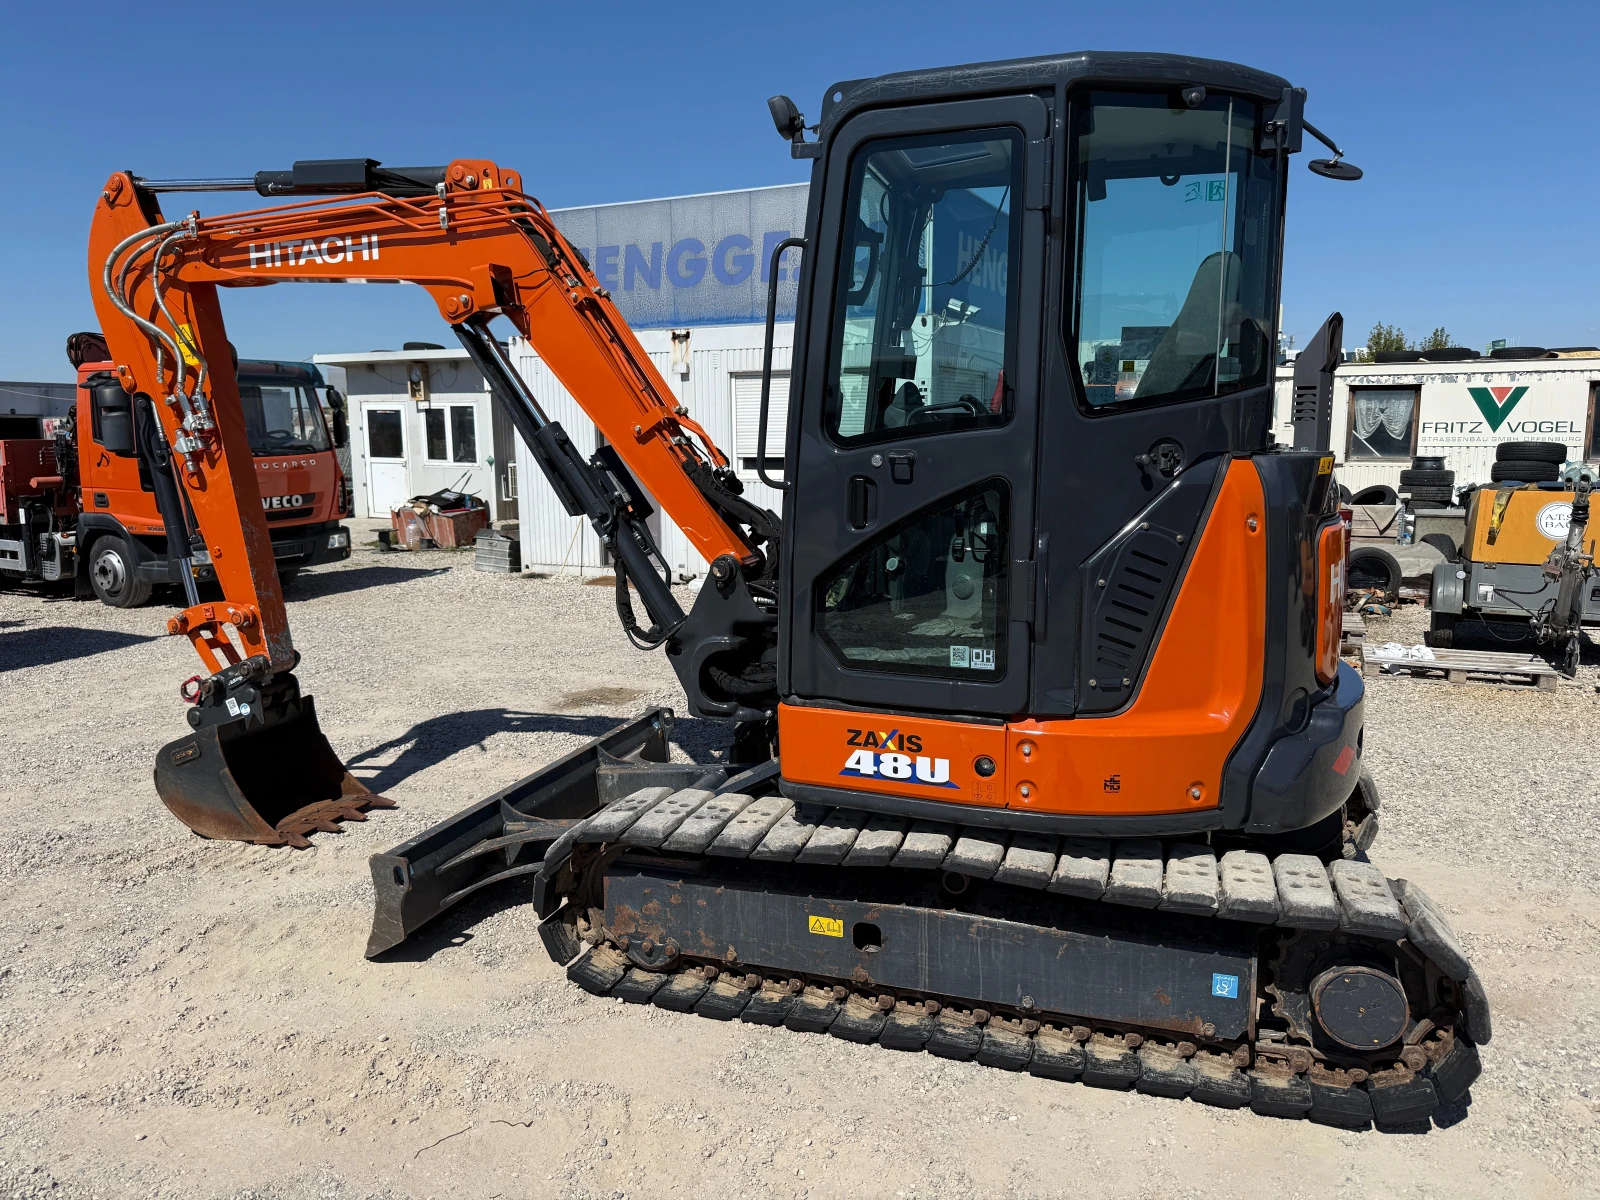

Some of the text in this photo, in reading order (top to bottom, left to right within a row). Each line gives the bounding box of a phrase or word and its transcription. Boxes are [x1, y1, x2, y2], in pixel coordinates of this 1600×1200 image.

[249, 233, 379, 269] HITACHI
[578, 230, 801, 292] ENGGE
[1422, 420, 1582, 434] FRITZ VOGEL
[972, 649, 994, 664] OK
[846, 728, 923, 753] ZAXIS
[844, 749, 950, 785] 48U
